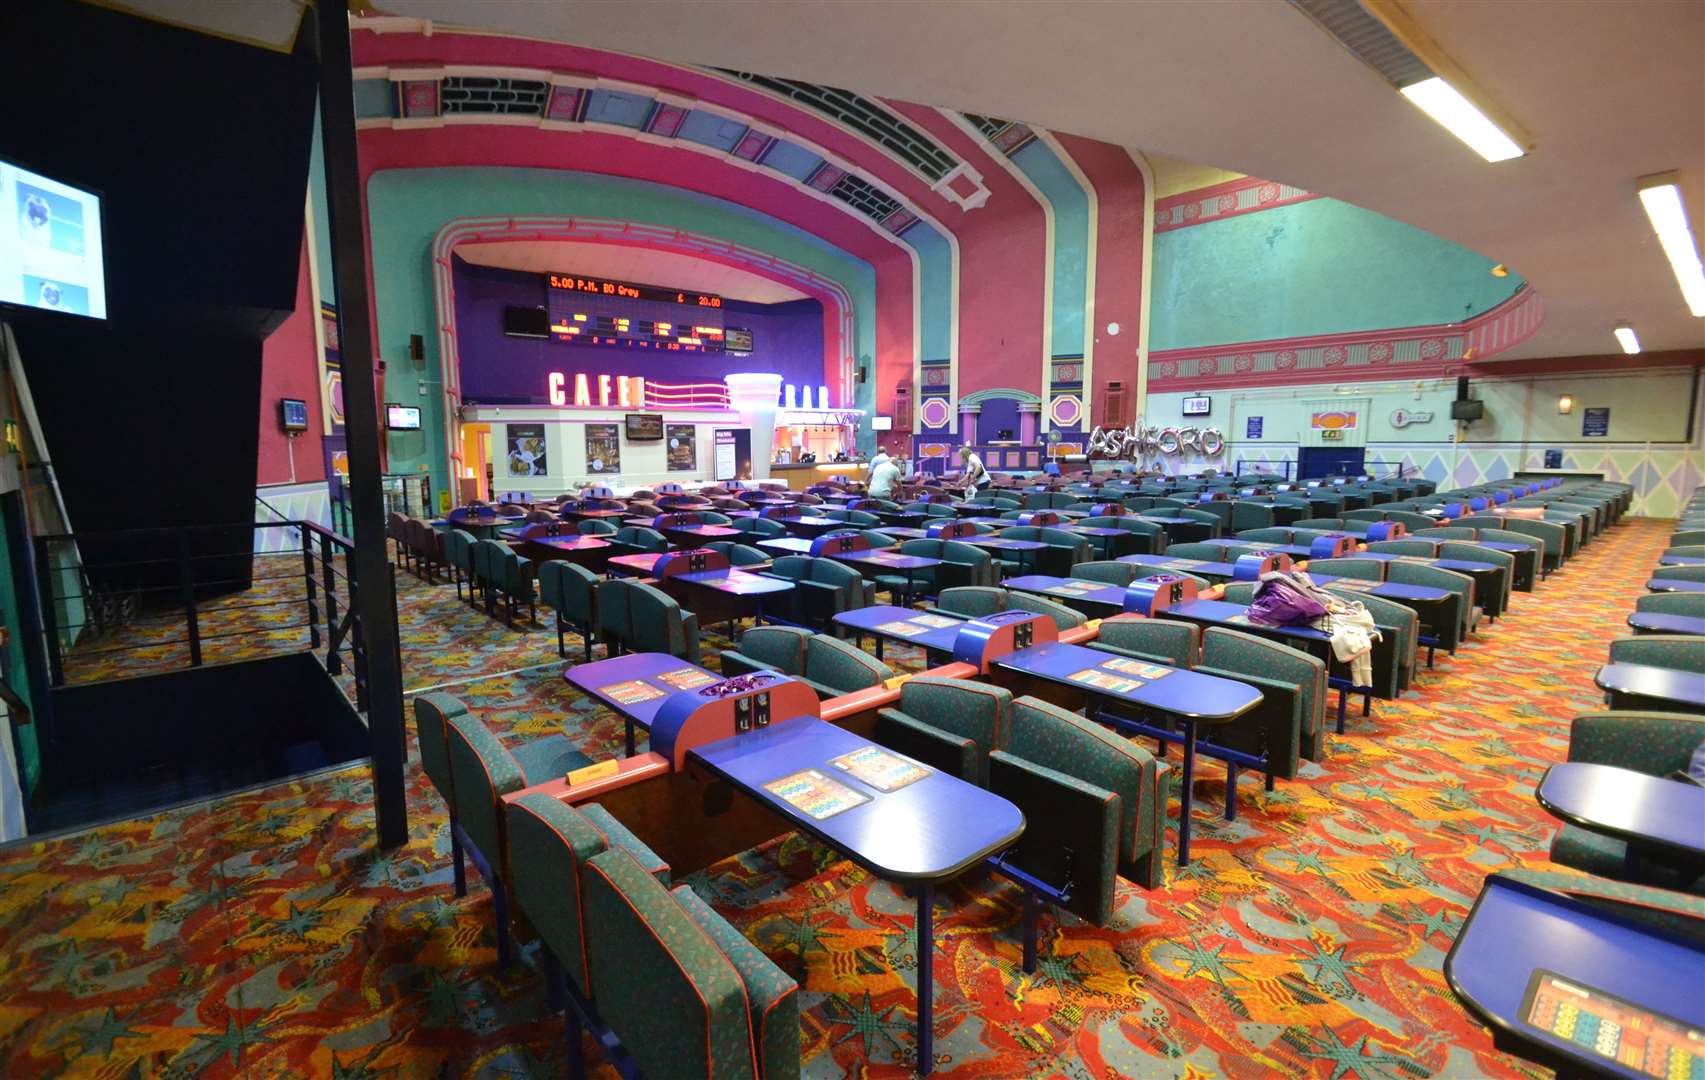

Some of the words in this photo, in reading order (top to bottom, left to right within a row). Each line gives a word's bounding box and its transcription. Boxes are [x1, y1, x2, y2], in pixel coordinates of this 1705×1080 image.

[551, 276, 574, 289] 5.00
[577, 279, 599, 292] P.M.
[617, 285, 640, 298] Grey
[698, 296, 721, 308] 20.00
[549, 372, 630, 407] CAFE
[784, 383, 829, 409] BAR
